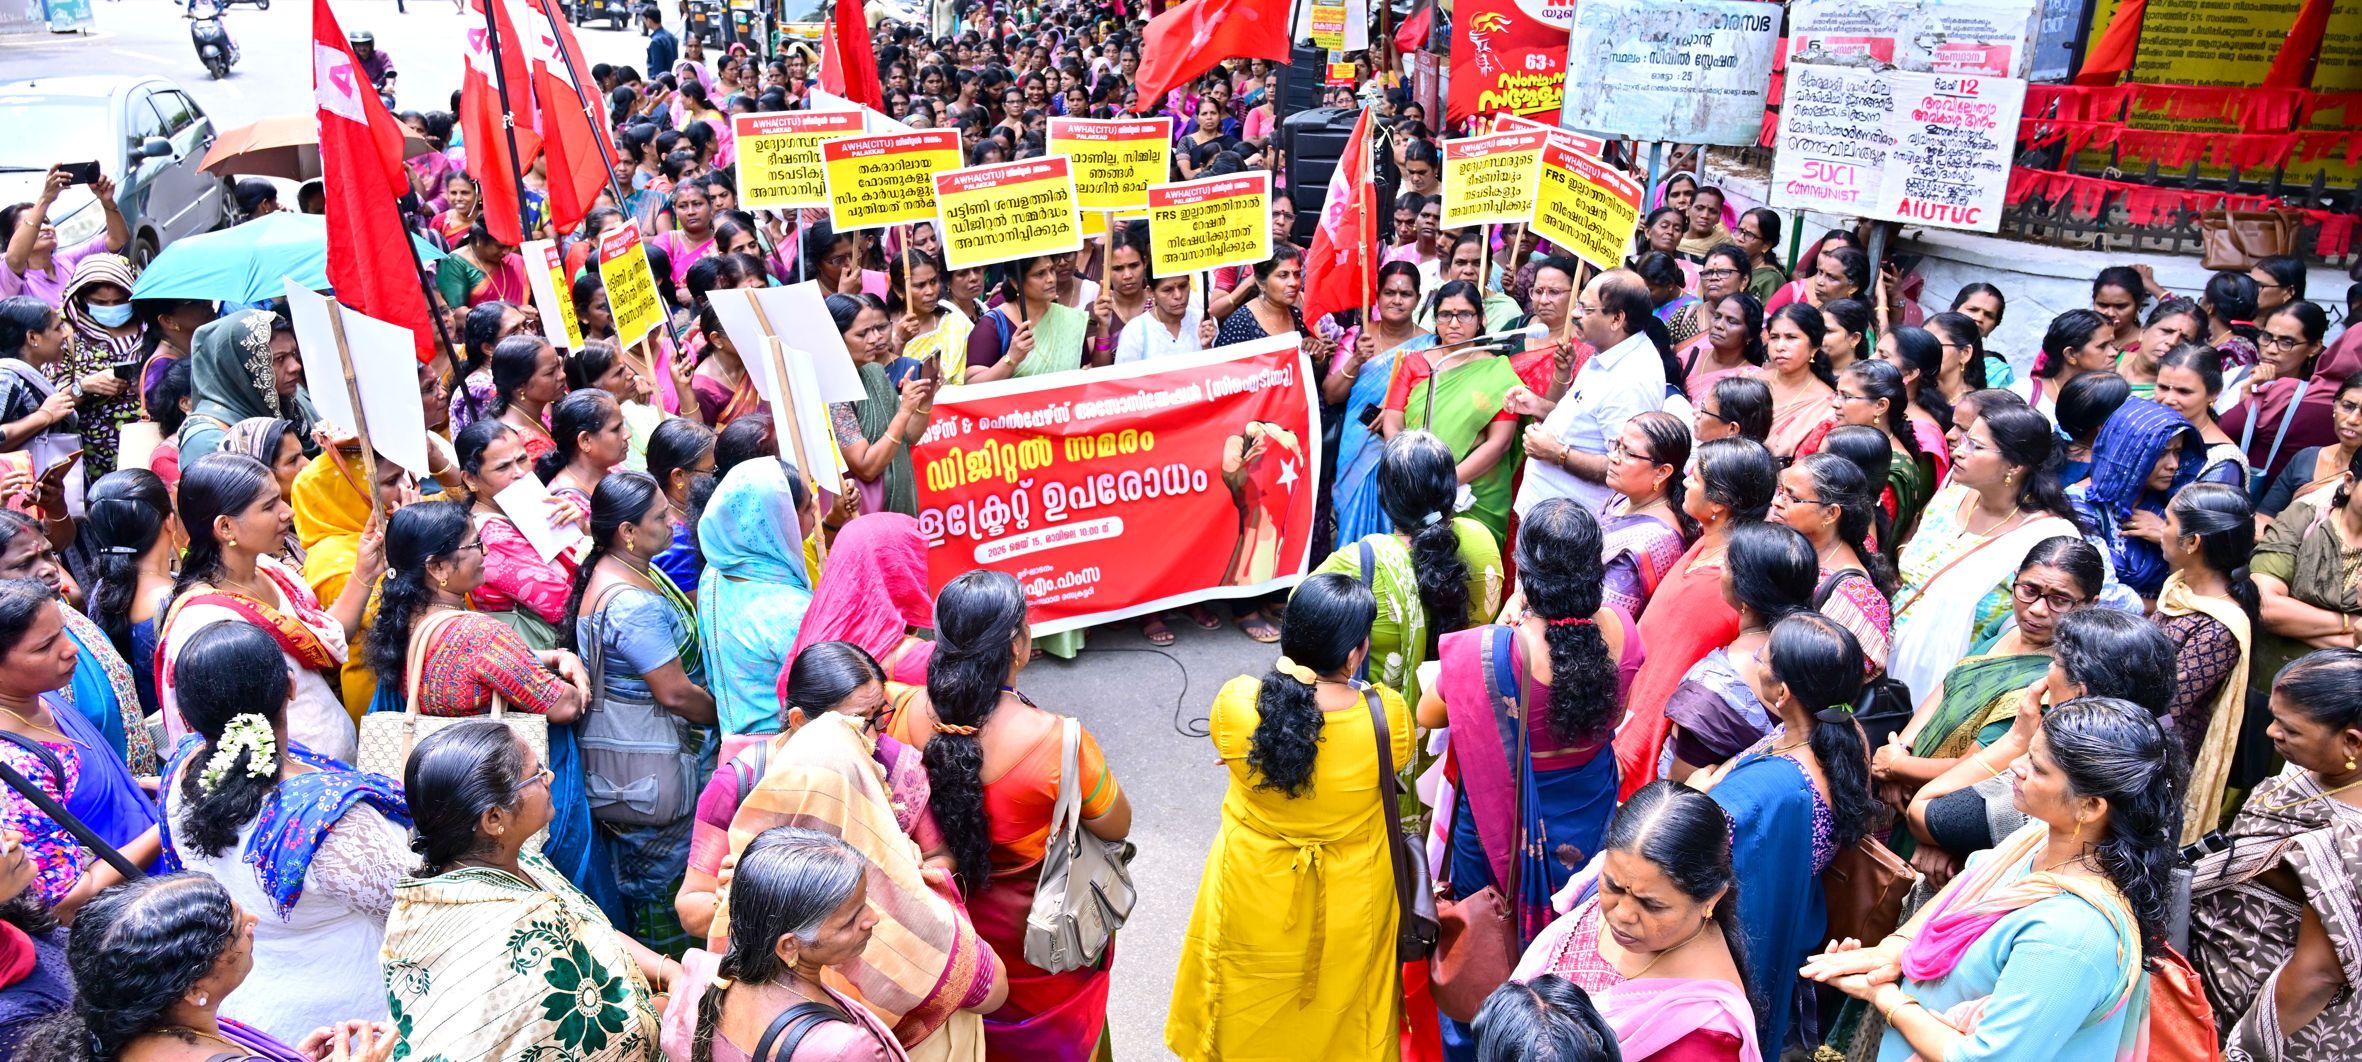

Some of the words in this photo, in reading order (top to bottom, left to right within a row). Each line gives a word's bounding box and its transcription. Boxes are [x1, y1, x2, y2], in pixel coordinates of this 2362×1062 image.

[1649, 51, 1690, 66] സിവിൽ
[1681, 72, 1693, 81] 25
[1870, 79, 1891, 96] വില
[1959, 79, 1979, 95] 12
[752, 115, 801, 129] AWHA(CITU)
[1067, 124, 1117, 135] AWHA(CITU)
[762, 127, 792, 135] PALAKKAD
[1076, 133, 1108, 141] PALAKKAD
[755, 136, 840, 153] ഉദ്യോഗസ്ഥ
[841, 139, 895, 152] AWHA(CITU)
[851, 149, 885, 157] PALAKKAD
[1459, 139, 1496, 154] AWHA(CITU)
[858, 159, 932, 174] തകരാറിലായ
[1089, 166, 1135, 179] ഞങ്ങൾ
[1459, 154, 1534, 175] ഉദ്യോഗസ്ഥരുടെ
[1558, 152, 1600, 178] AWHA(CITU)
[1565, 163, 1591, 180] PALAKKAD
[1801, 161, 1854, 185] SUCI
[953, 170, 1005, 186] AWHA(CITU)
[964, 181, 997, 191] PALAKKAD
[1122, 178, 1150, 193] ഓഫ്
[1467, 170, 1522, 186] ഭീഷണിയും
[749, 181, 826, 198] അവസാനിപ്പി
[1165, 187, 1210, 199] AWHA(CITU)
[1464, 185, 1522, 201] നടപടികളും
[1545, 168, 1565, 183] FRS
[1568, 177, 1635, 224] ഇല്ലാത്തതിനാൽ
[1786, 180, 1860, 203] COMMUNIST
[835, 193, 858, 205] സിം
[847, 201, 900, 217] പുതിയത്
[904, 198, 936, 211] നൽക
[946, 199, 990, 219] പട്ടിണി
[994, 189, 1068, 210] ശമ്പളത്തിൽ
[1155, 211, 1177, 221] FRS
[1180, 196, 1260, 221] ഇല്ലാത്തതിനാൽ
[1575, 198, 1608, 221] റേഷൻ
[1897, 197, 1982, 225] AIUTUC
[951, 214, 1007, 234] ഡിജിറ്റൽ
[1192, 215, 1226, 231] റേഷൻ
[1550, 201, 1624, 249] നിഷേധിക്കുന്നത്
[954, 223, 1071, 250] അവസാനിപ്പിക്കുക
[1167, 225, 1253, 249] നിഷേധിക്കുന്നത്
[1162, 240, 1257, 264] അവസാനിപ്പിക്കുക
[961, 417, 973, 435] &
[979, 401, 1072, 430] ഹെൽപ്പേഴ്സ്
[1074, 383, 1202, 421] അസോസിയേഷൻ
[926, 435, 1054, 492] ഡിജിറ്റൽ
[1064, 428, 1155, 463] സമരം
[1042, 462, 1208, 522] ഉപരോധം
[988, 546, 1006, 558] 2026
[1009, 537, 1030, 552] മെയ്
[1032, 537, 1043, 547] 15,
[1045, 530, 1076, 544] രാവിലെ
[1079, 527, 1099, 537] 10:00
